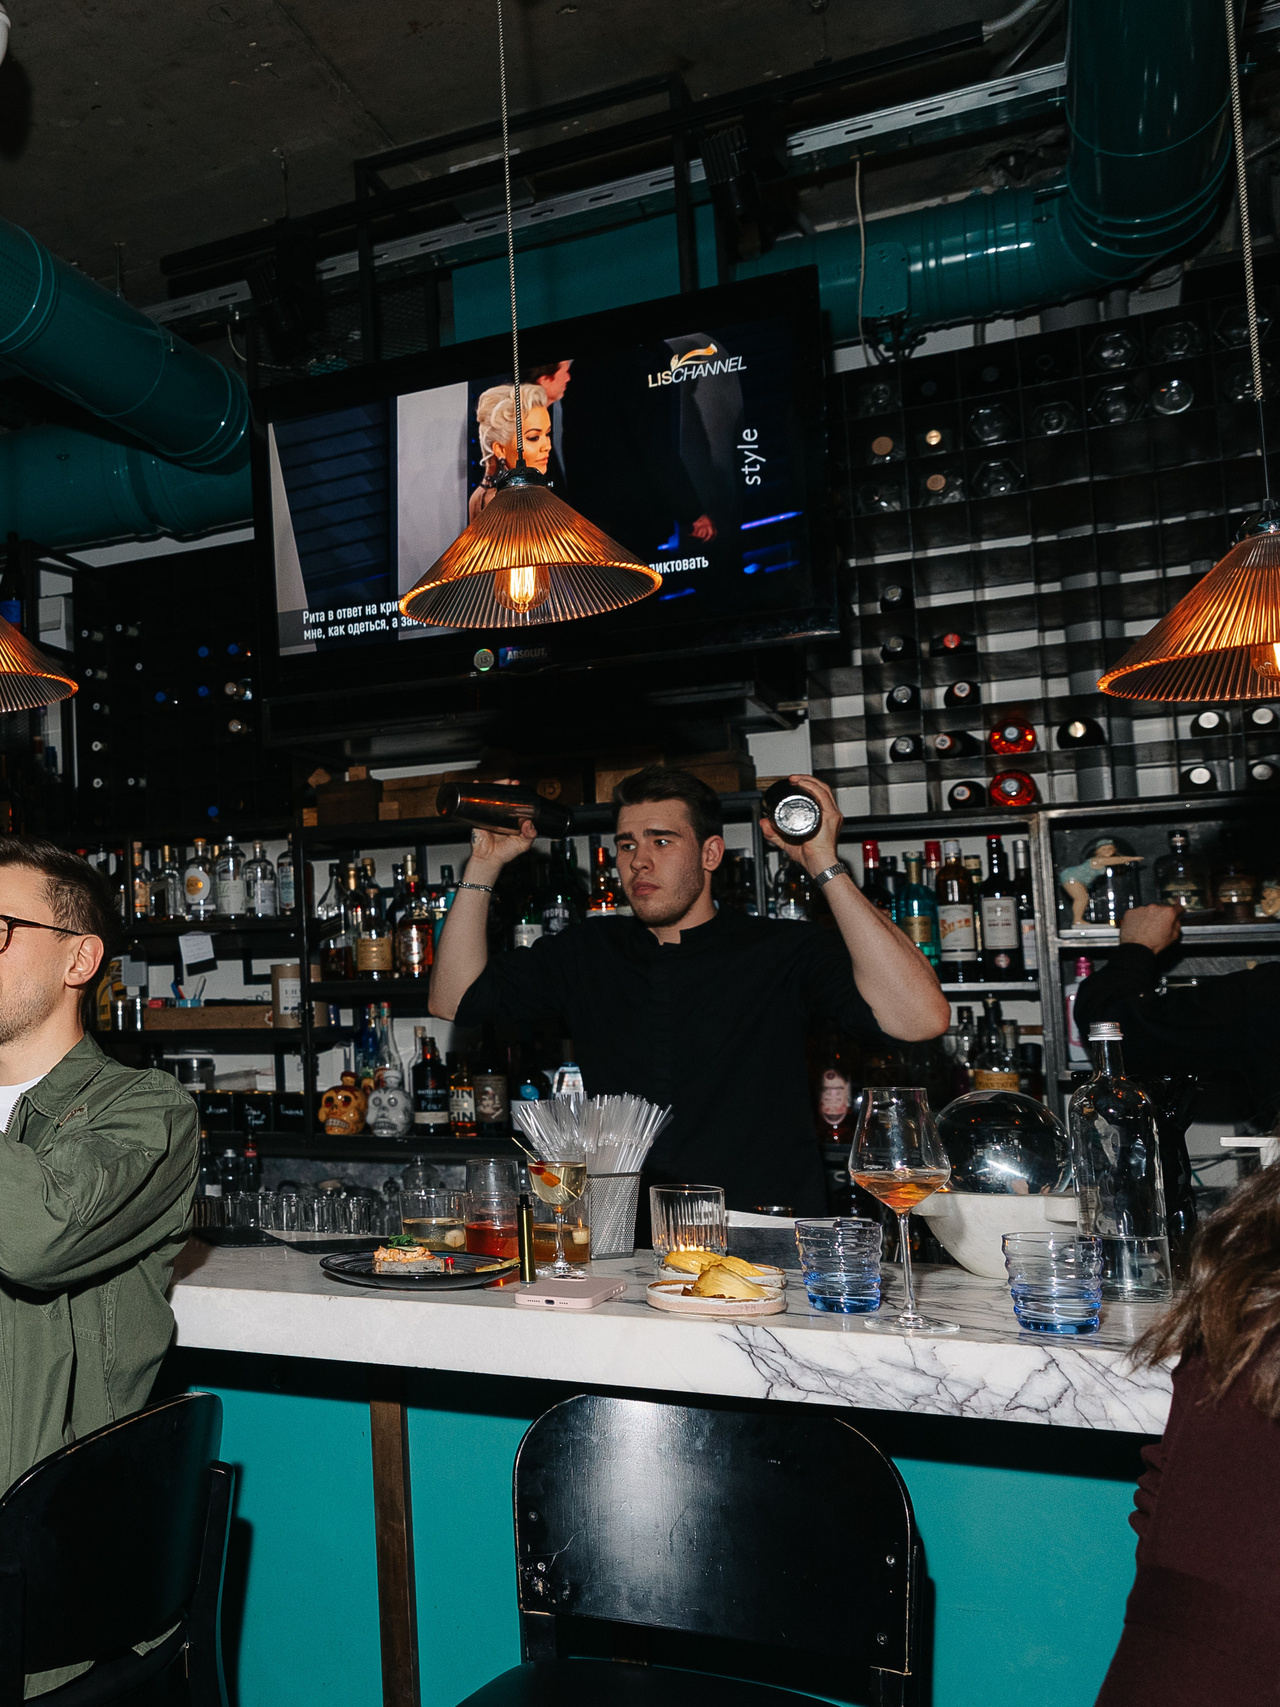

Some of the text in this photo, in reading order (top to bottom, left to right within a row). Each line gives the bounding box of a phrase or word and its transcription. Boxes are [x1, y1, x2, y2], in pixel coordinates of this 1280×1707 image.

[737, 428, 766, 485] style
[303, 610, 325, 624] Рита
[328, 610, 334, 621] в
[336, 606, 363, 620] ответ
[365, 604, 377, 616] на
[380, 601, 400, 616] кри
[303, 628, 326, 640] мне,
[328, 626, 345, 637] как
[347, 618, 389, 636] одеться,
[392, 617, 398, 628] а
